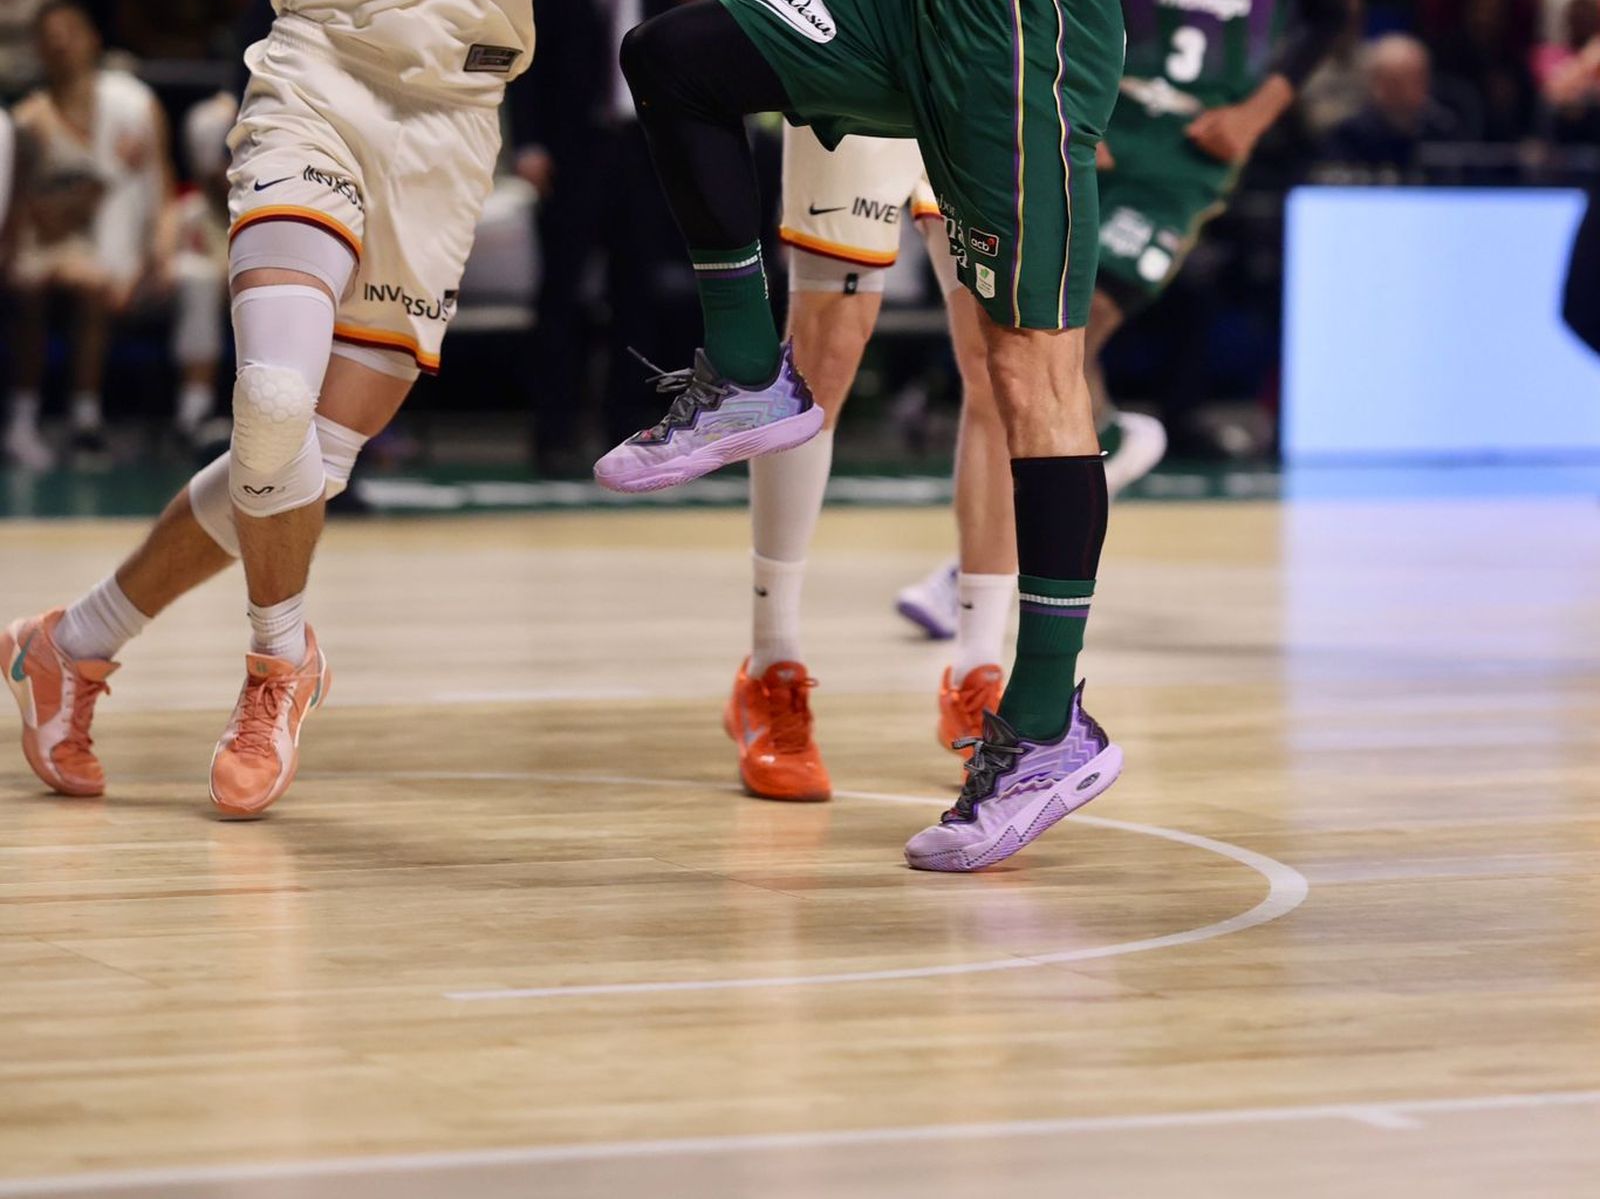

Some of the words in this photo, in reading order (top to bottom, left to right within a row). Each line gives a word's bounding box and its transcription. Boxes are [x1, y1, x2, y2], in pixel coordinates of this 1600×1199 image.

[1165, 25, 1208, 83] 3
[852, 196, 899, 224] INVE
[364, 282, 447, 322] INVRSU
